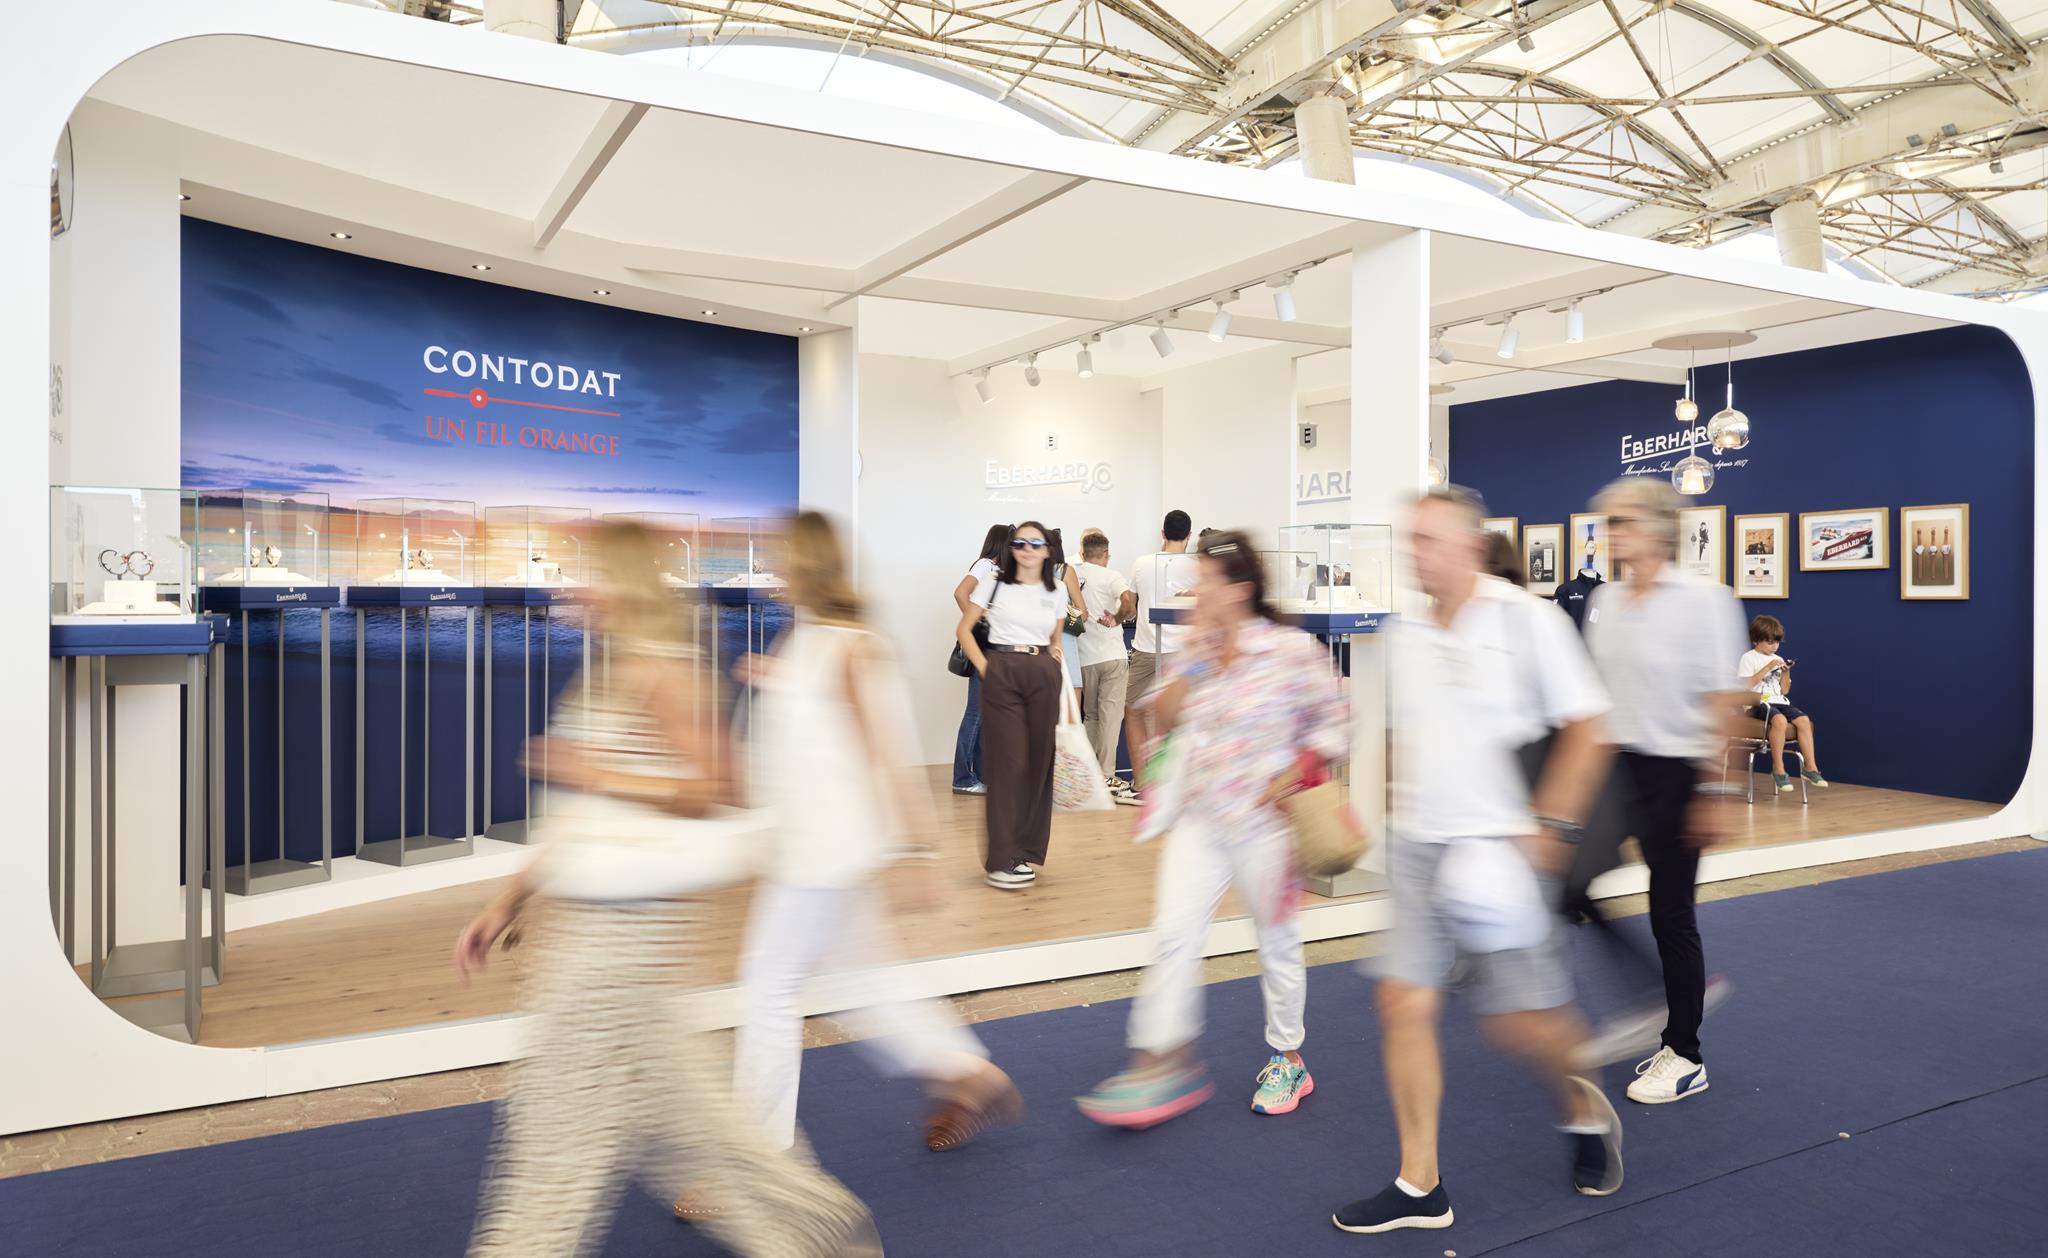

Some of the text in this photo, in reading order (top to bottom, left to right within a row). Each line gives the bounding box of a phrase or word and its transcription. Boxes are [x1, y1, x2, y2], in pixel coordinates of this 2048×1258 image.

[423, 345, 621, 397] CONTODAT
[426, 415, 621, 456] UN FIL ORANGE
[1621, 426, 1709, 460] EBERHAR
